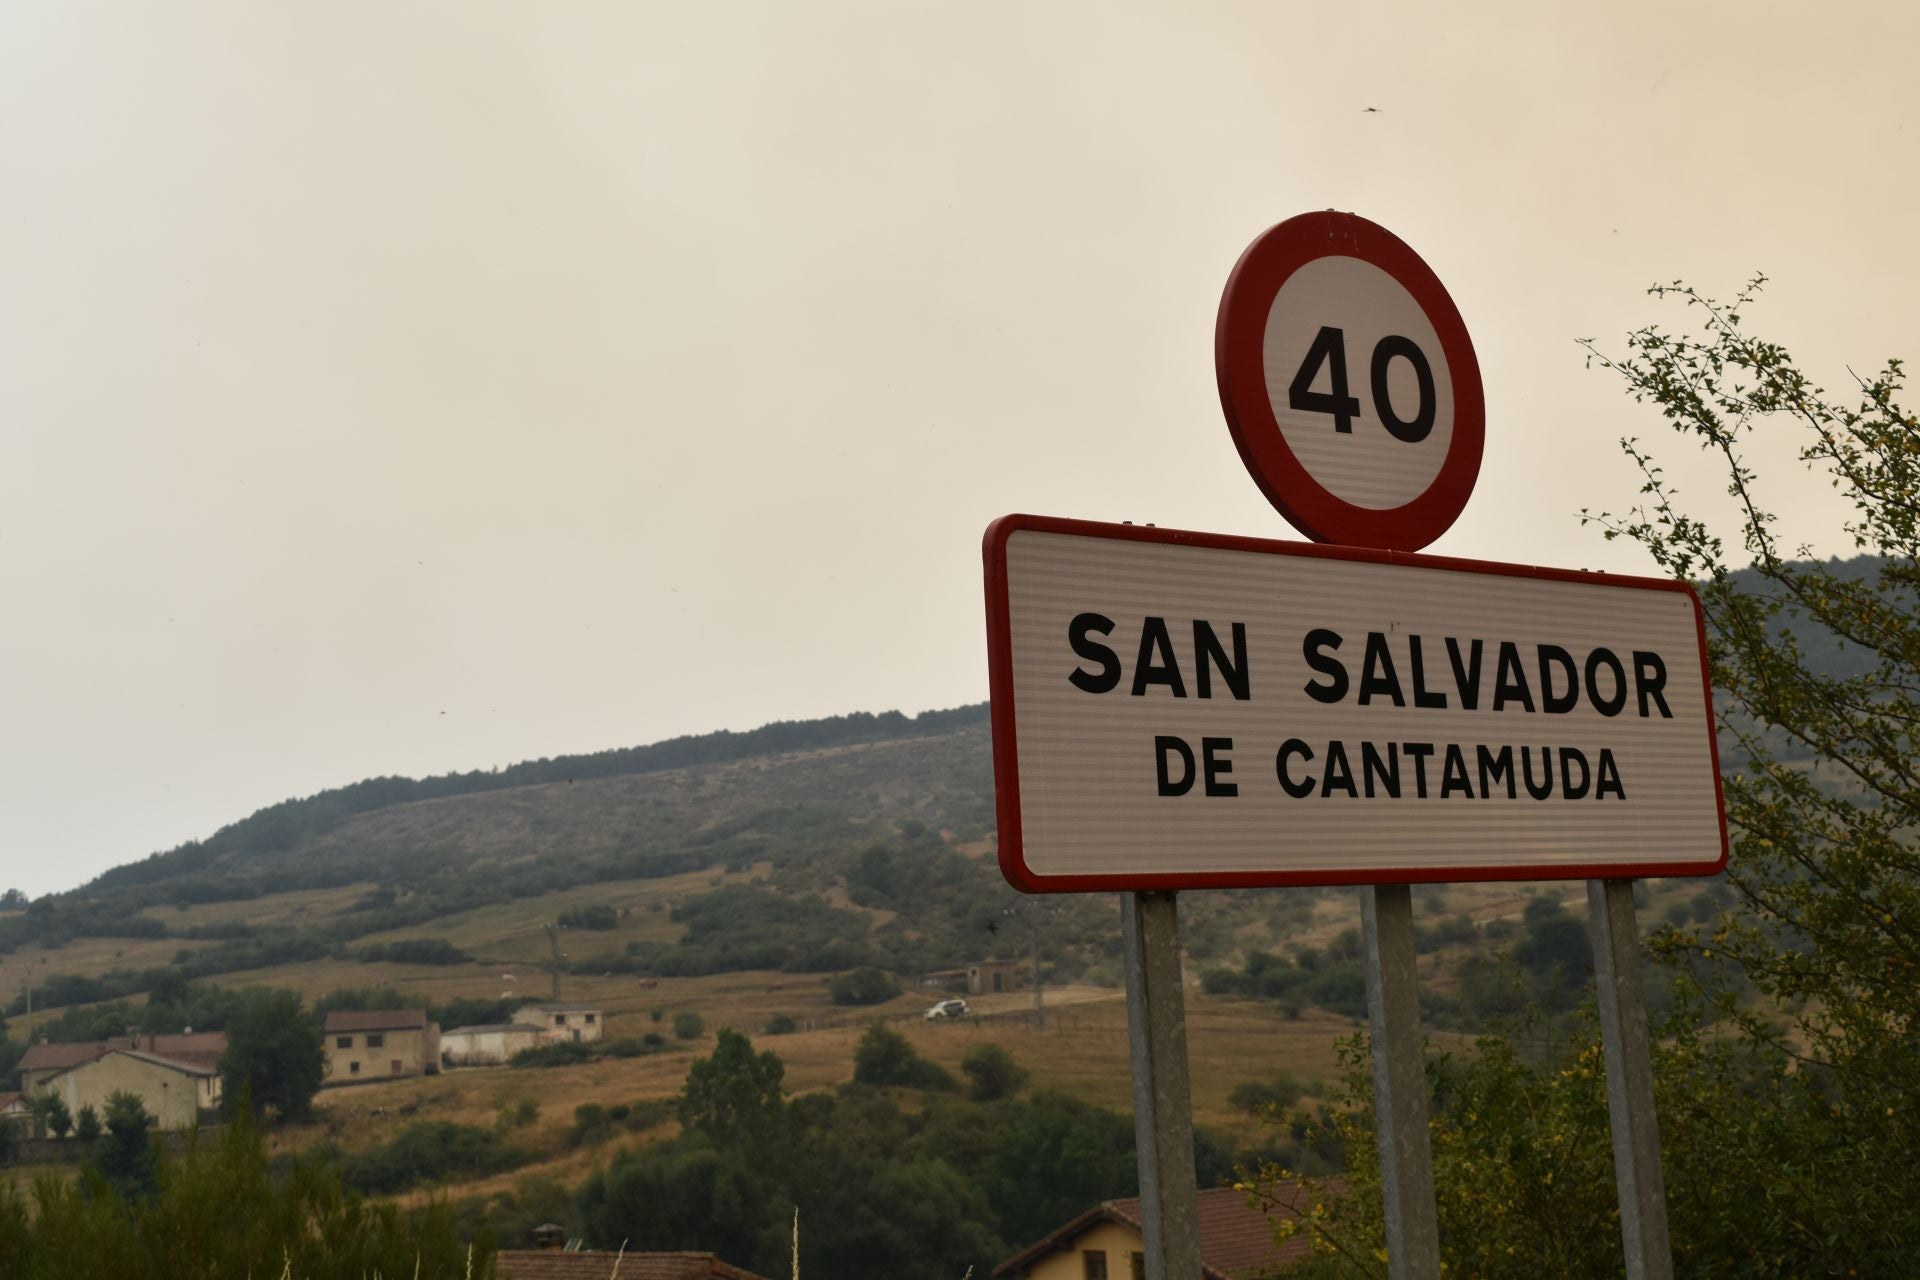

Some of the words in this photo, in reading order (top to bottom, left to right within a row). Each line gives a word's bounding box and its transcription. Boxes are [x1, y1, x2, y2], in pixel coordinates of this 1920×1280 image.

[1288, 325, 1437, 444] 40
[1067, 612, 1251, 701] SAN
[1302, 628, 1674, 720] SALVADOR
[1154, 735, 1239, 798] DE
[1275, 737, 1627, 801] CANTAMUDA
